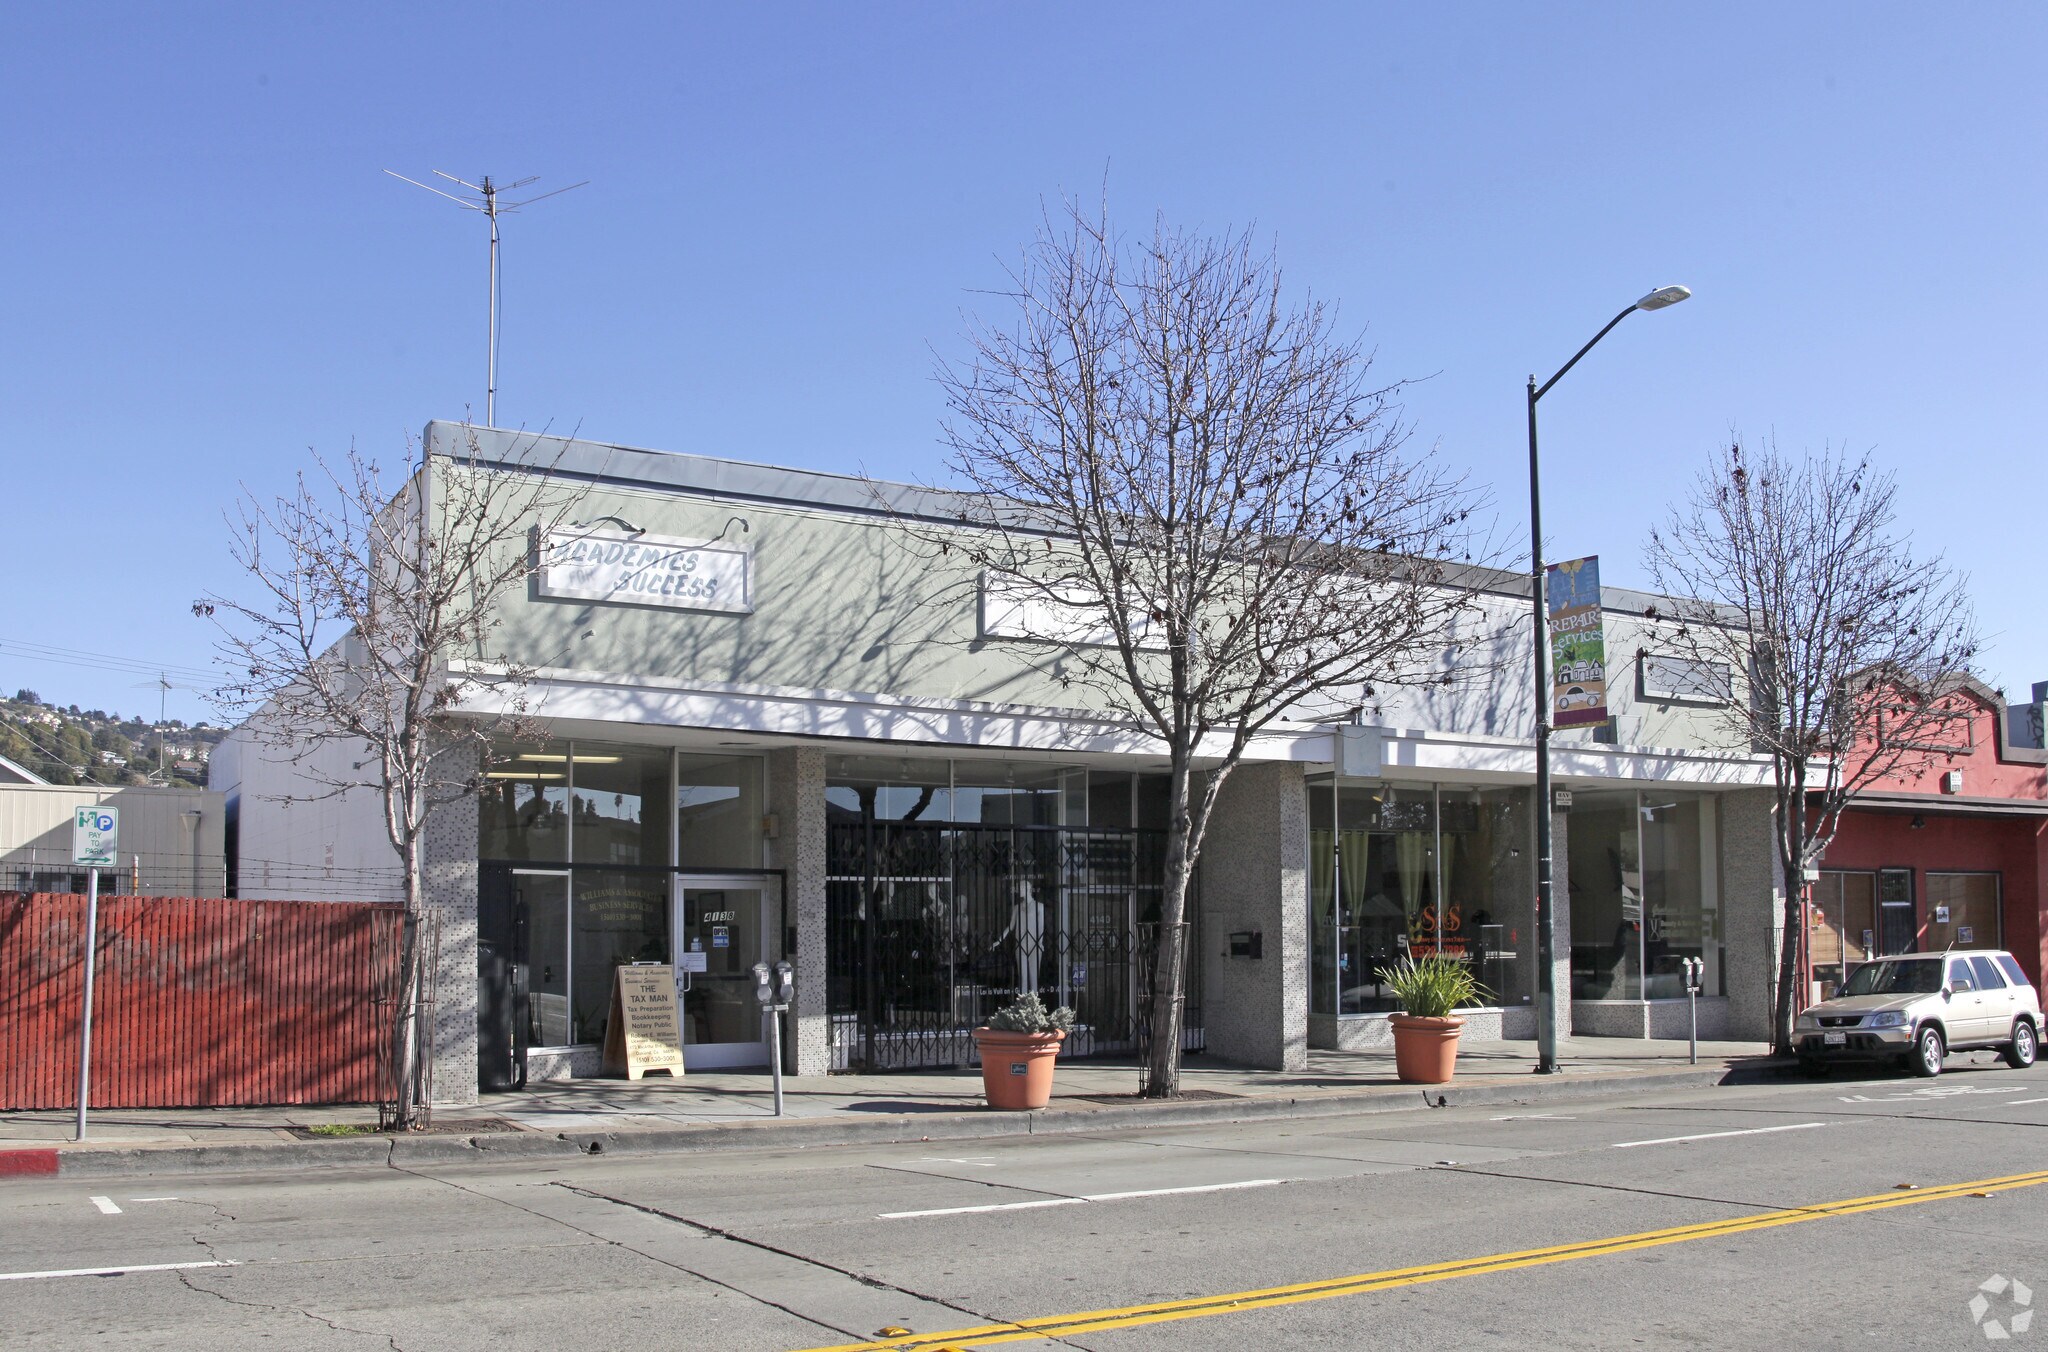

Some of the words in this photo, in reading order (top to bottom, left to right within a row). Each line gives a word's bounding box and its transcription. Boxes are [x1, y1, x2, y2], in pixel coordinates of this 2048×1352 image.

[553, 539, 700, 573] ACADEMICS
[614, 570, 719, 599] SUCCESS
[1550, 611, 1598, 633] REPAIR
[1552, 629, 1603, 659] Services
[580, 888, 615, 901] WILLIAMS
[589, 900, 621, 912] BUSINESS
[704, 911, 734, 922] 4138
